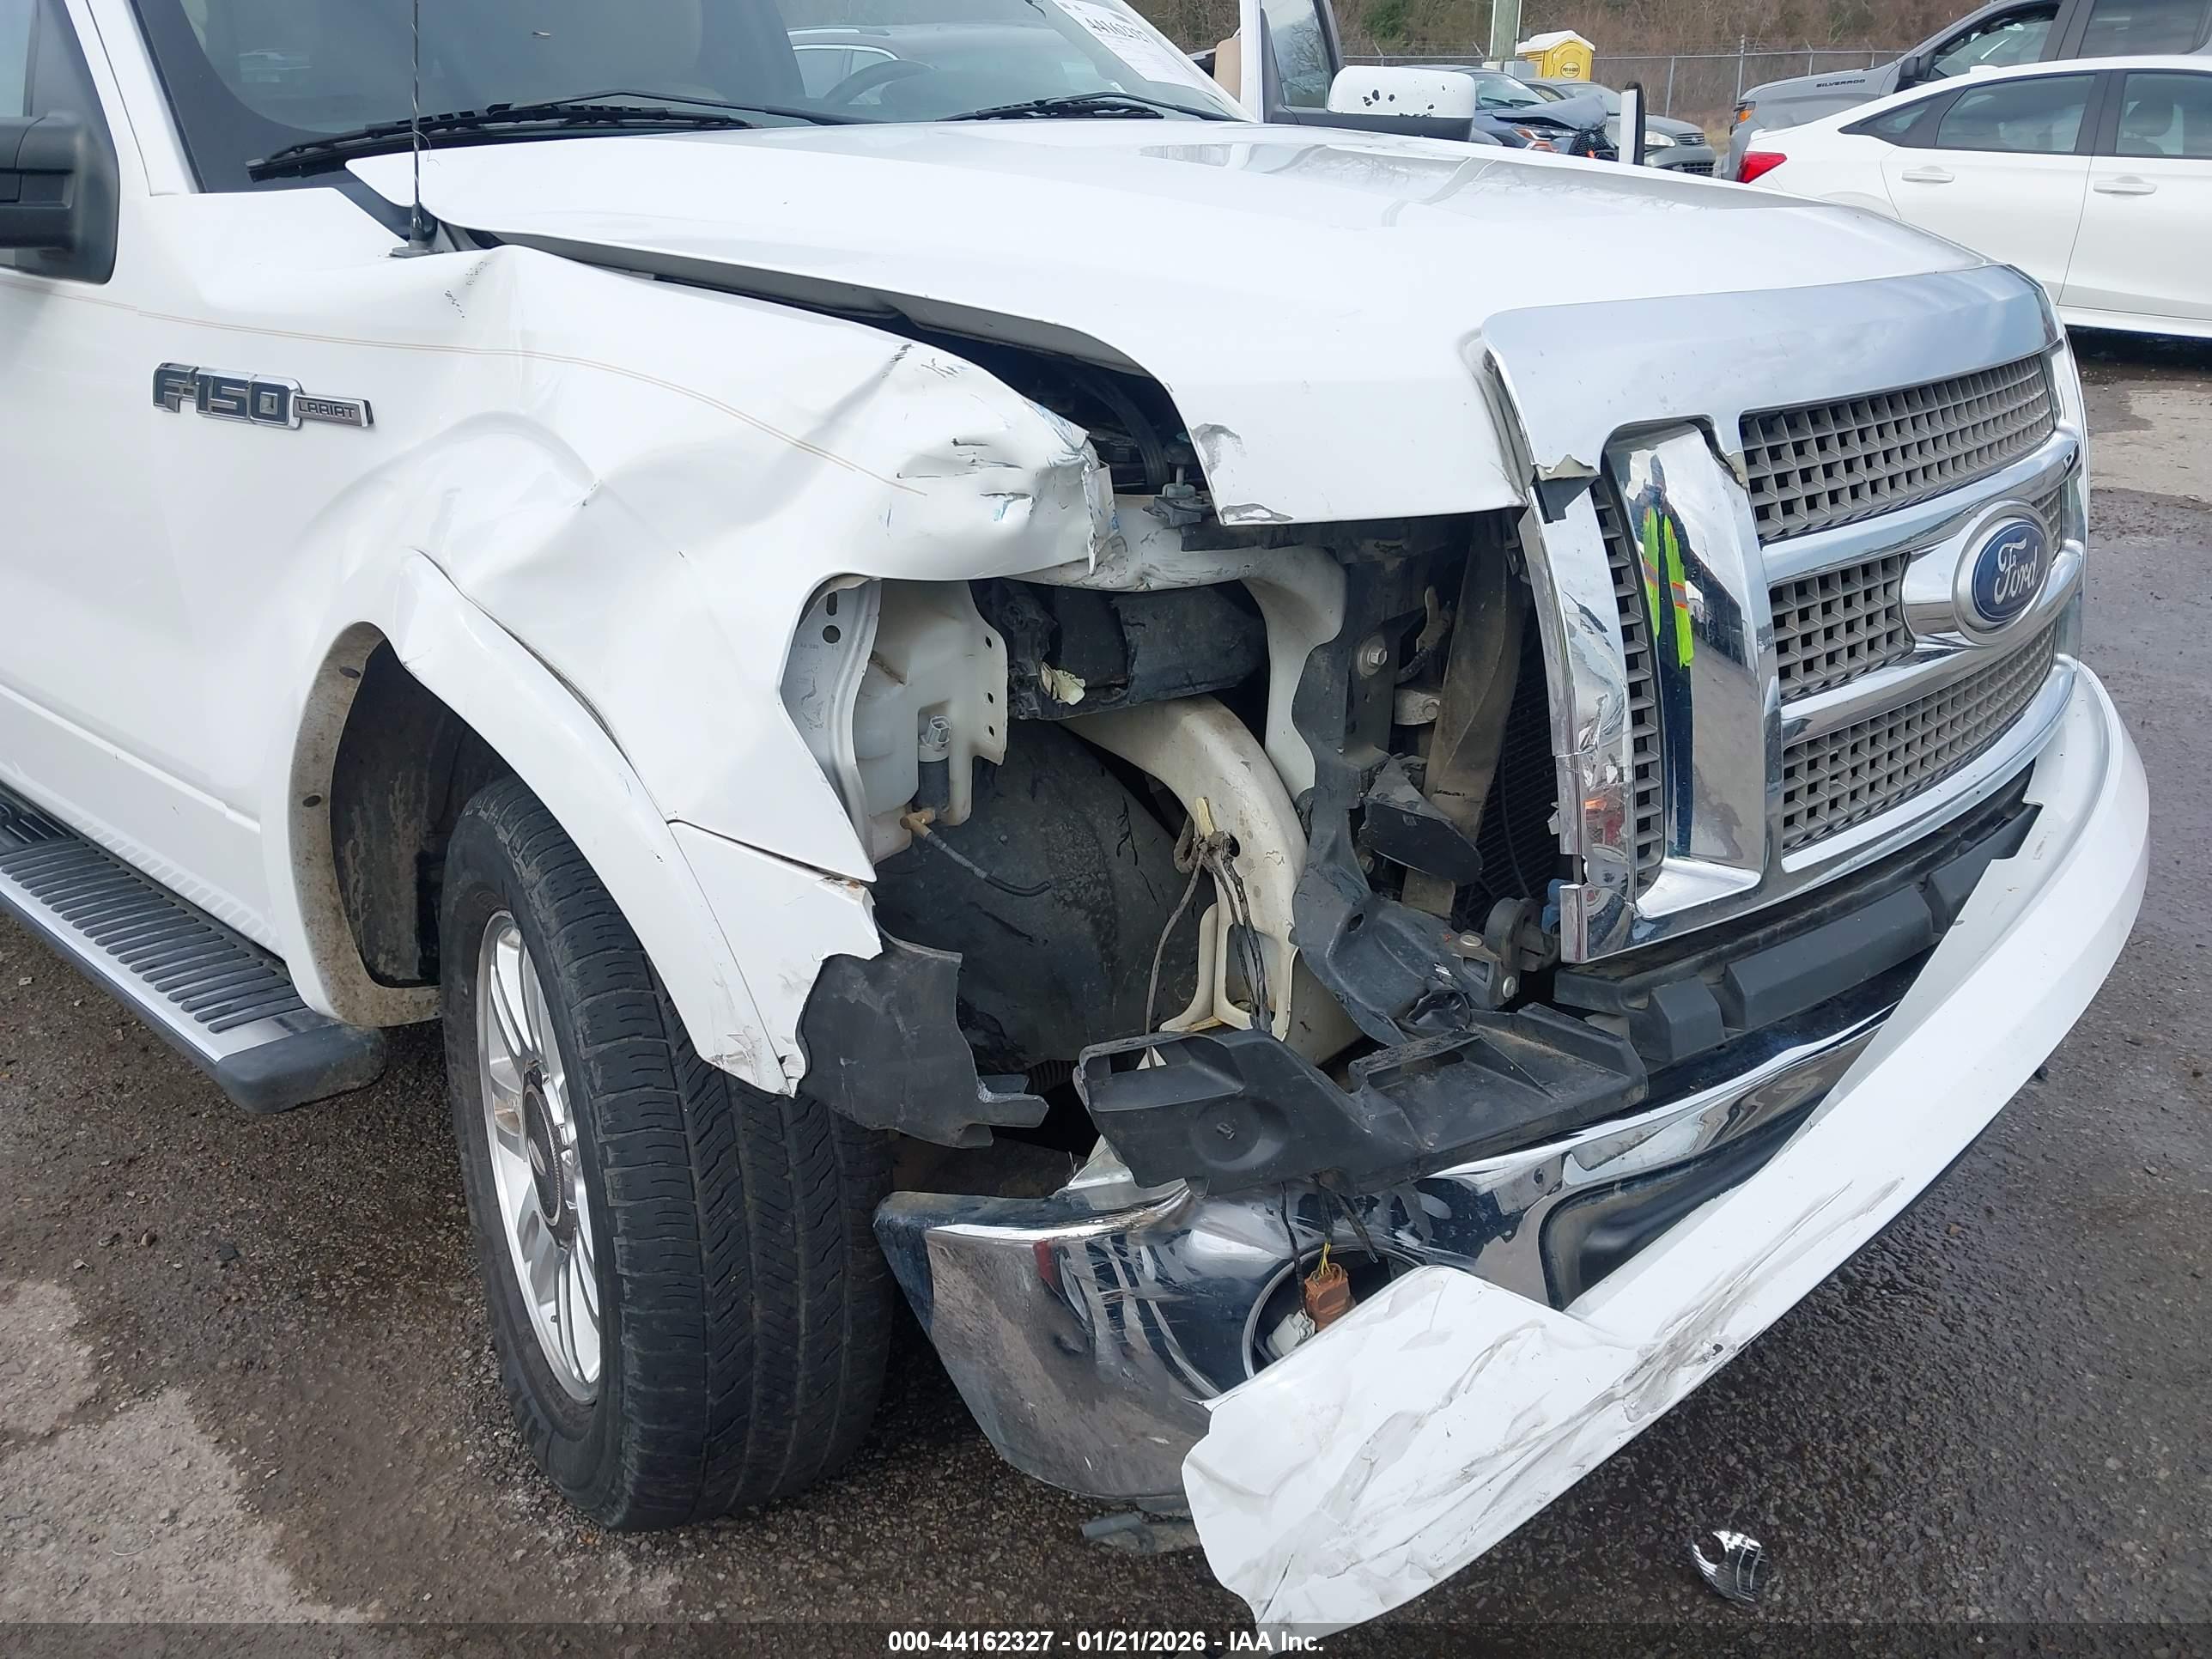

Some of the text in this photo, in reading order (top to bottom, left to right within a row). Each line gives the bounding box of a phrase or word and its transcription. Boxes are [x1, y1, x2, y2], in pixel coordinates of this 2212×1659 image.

[1816, 78, 1866, 88] SILVERADO
[298, 399, 356, 420] LARIAT
[1993, 537, 2039, 605] Ford
